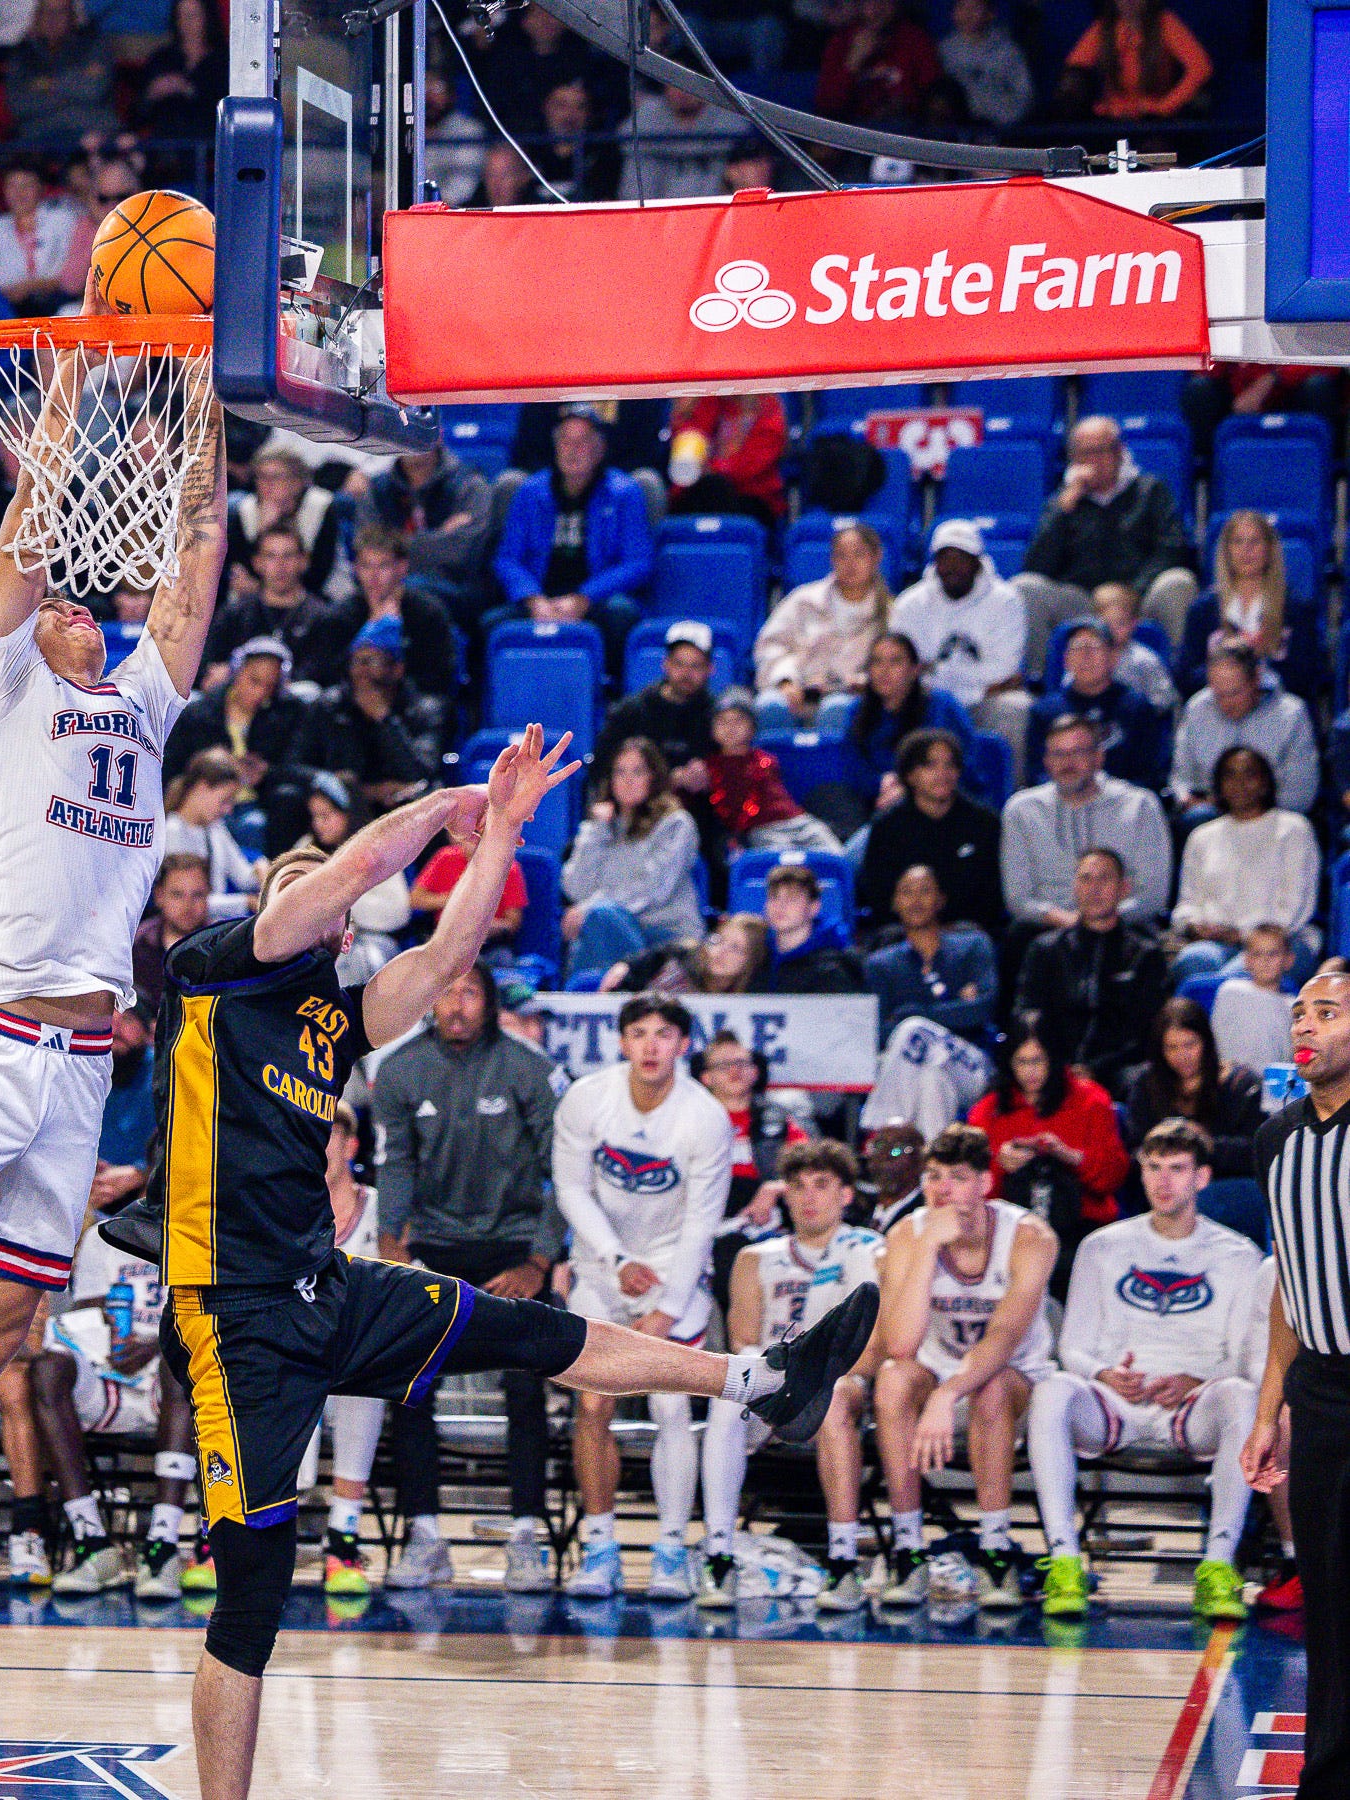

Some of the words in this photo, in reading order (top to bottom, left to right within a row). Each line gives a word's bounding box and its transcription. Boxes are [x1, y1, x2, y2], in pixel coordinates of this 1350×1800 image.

[89, 745, 137, 808] 11
[48, 798, 153, 847] ATLANTIC
[296, 995, 349, 1043] EAST
[298, 1025, 334, 1081] 43
[261, 1063, 338, 1122] CAROLIN
[791, 1296, 807, 1321] 2
